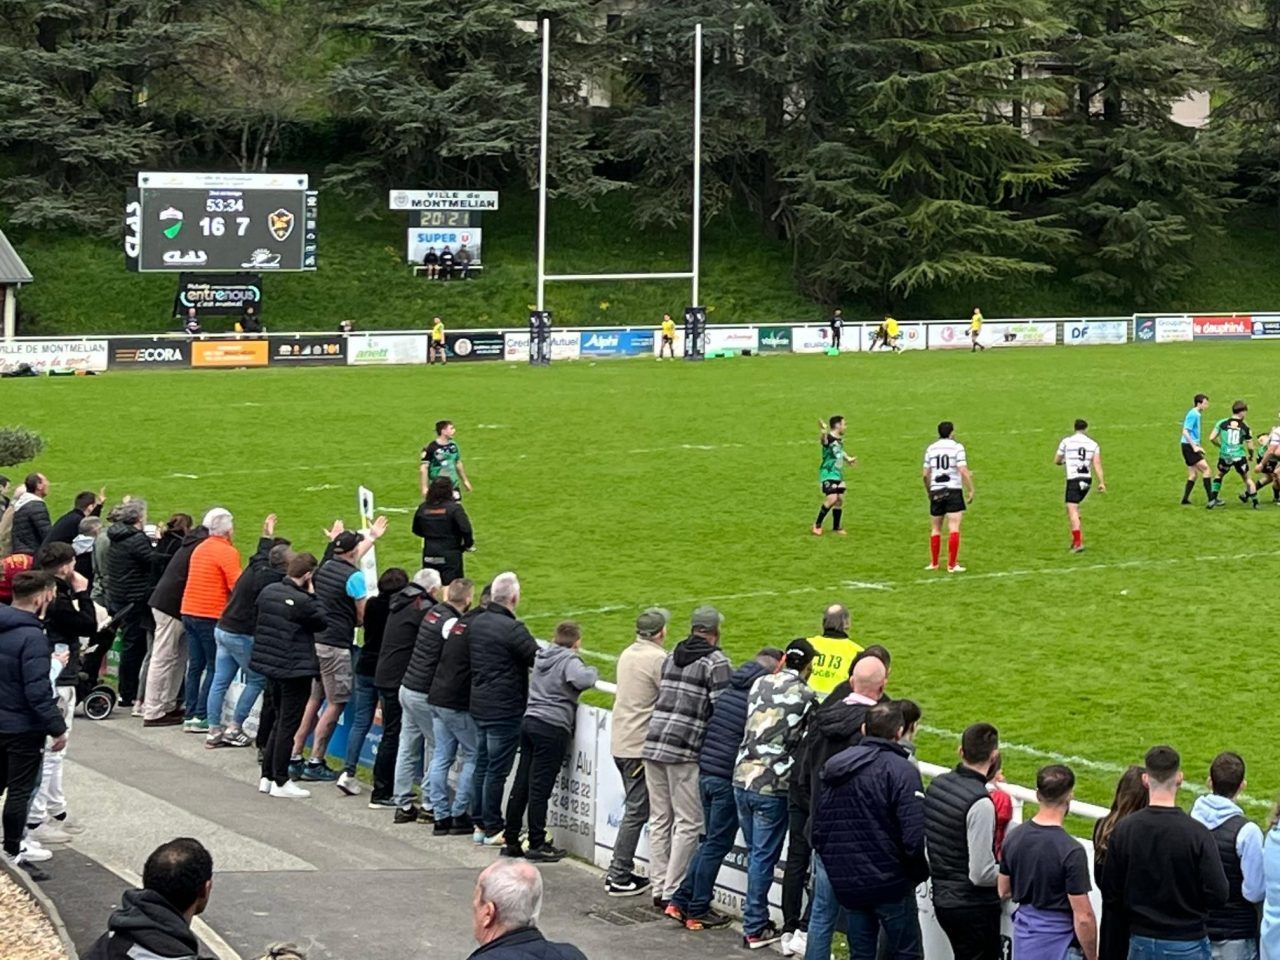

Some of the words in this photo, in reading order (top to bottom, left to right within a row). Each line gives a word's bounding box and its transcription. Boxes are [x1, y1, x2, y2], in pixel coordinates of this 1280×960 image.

[206, 198, 243, 212] 53:34
[411, 199, 495, 209] MONTMELIAN
[199, 217, 226, 237] 16
[236, 217, 251, 237] 7
[417, 233, 457, 243] SUPER
[187, 289, 254, 301] entrenous
[1071, 326, 1089, 339] DF
[26, 344, 38, 354] DE
[42, 343, 105, 353] MONTMELIAN
[135, 348, 183, 362] ECORA
[1078, 446, 1086, 461] 9
[935, 454, 949, 470] 10
[575, 750, 592, 776] Alu
